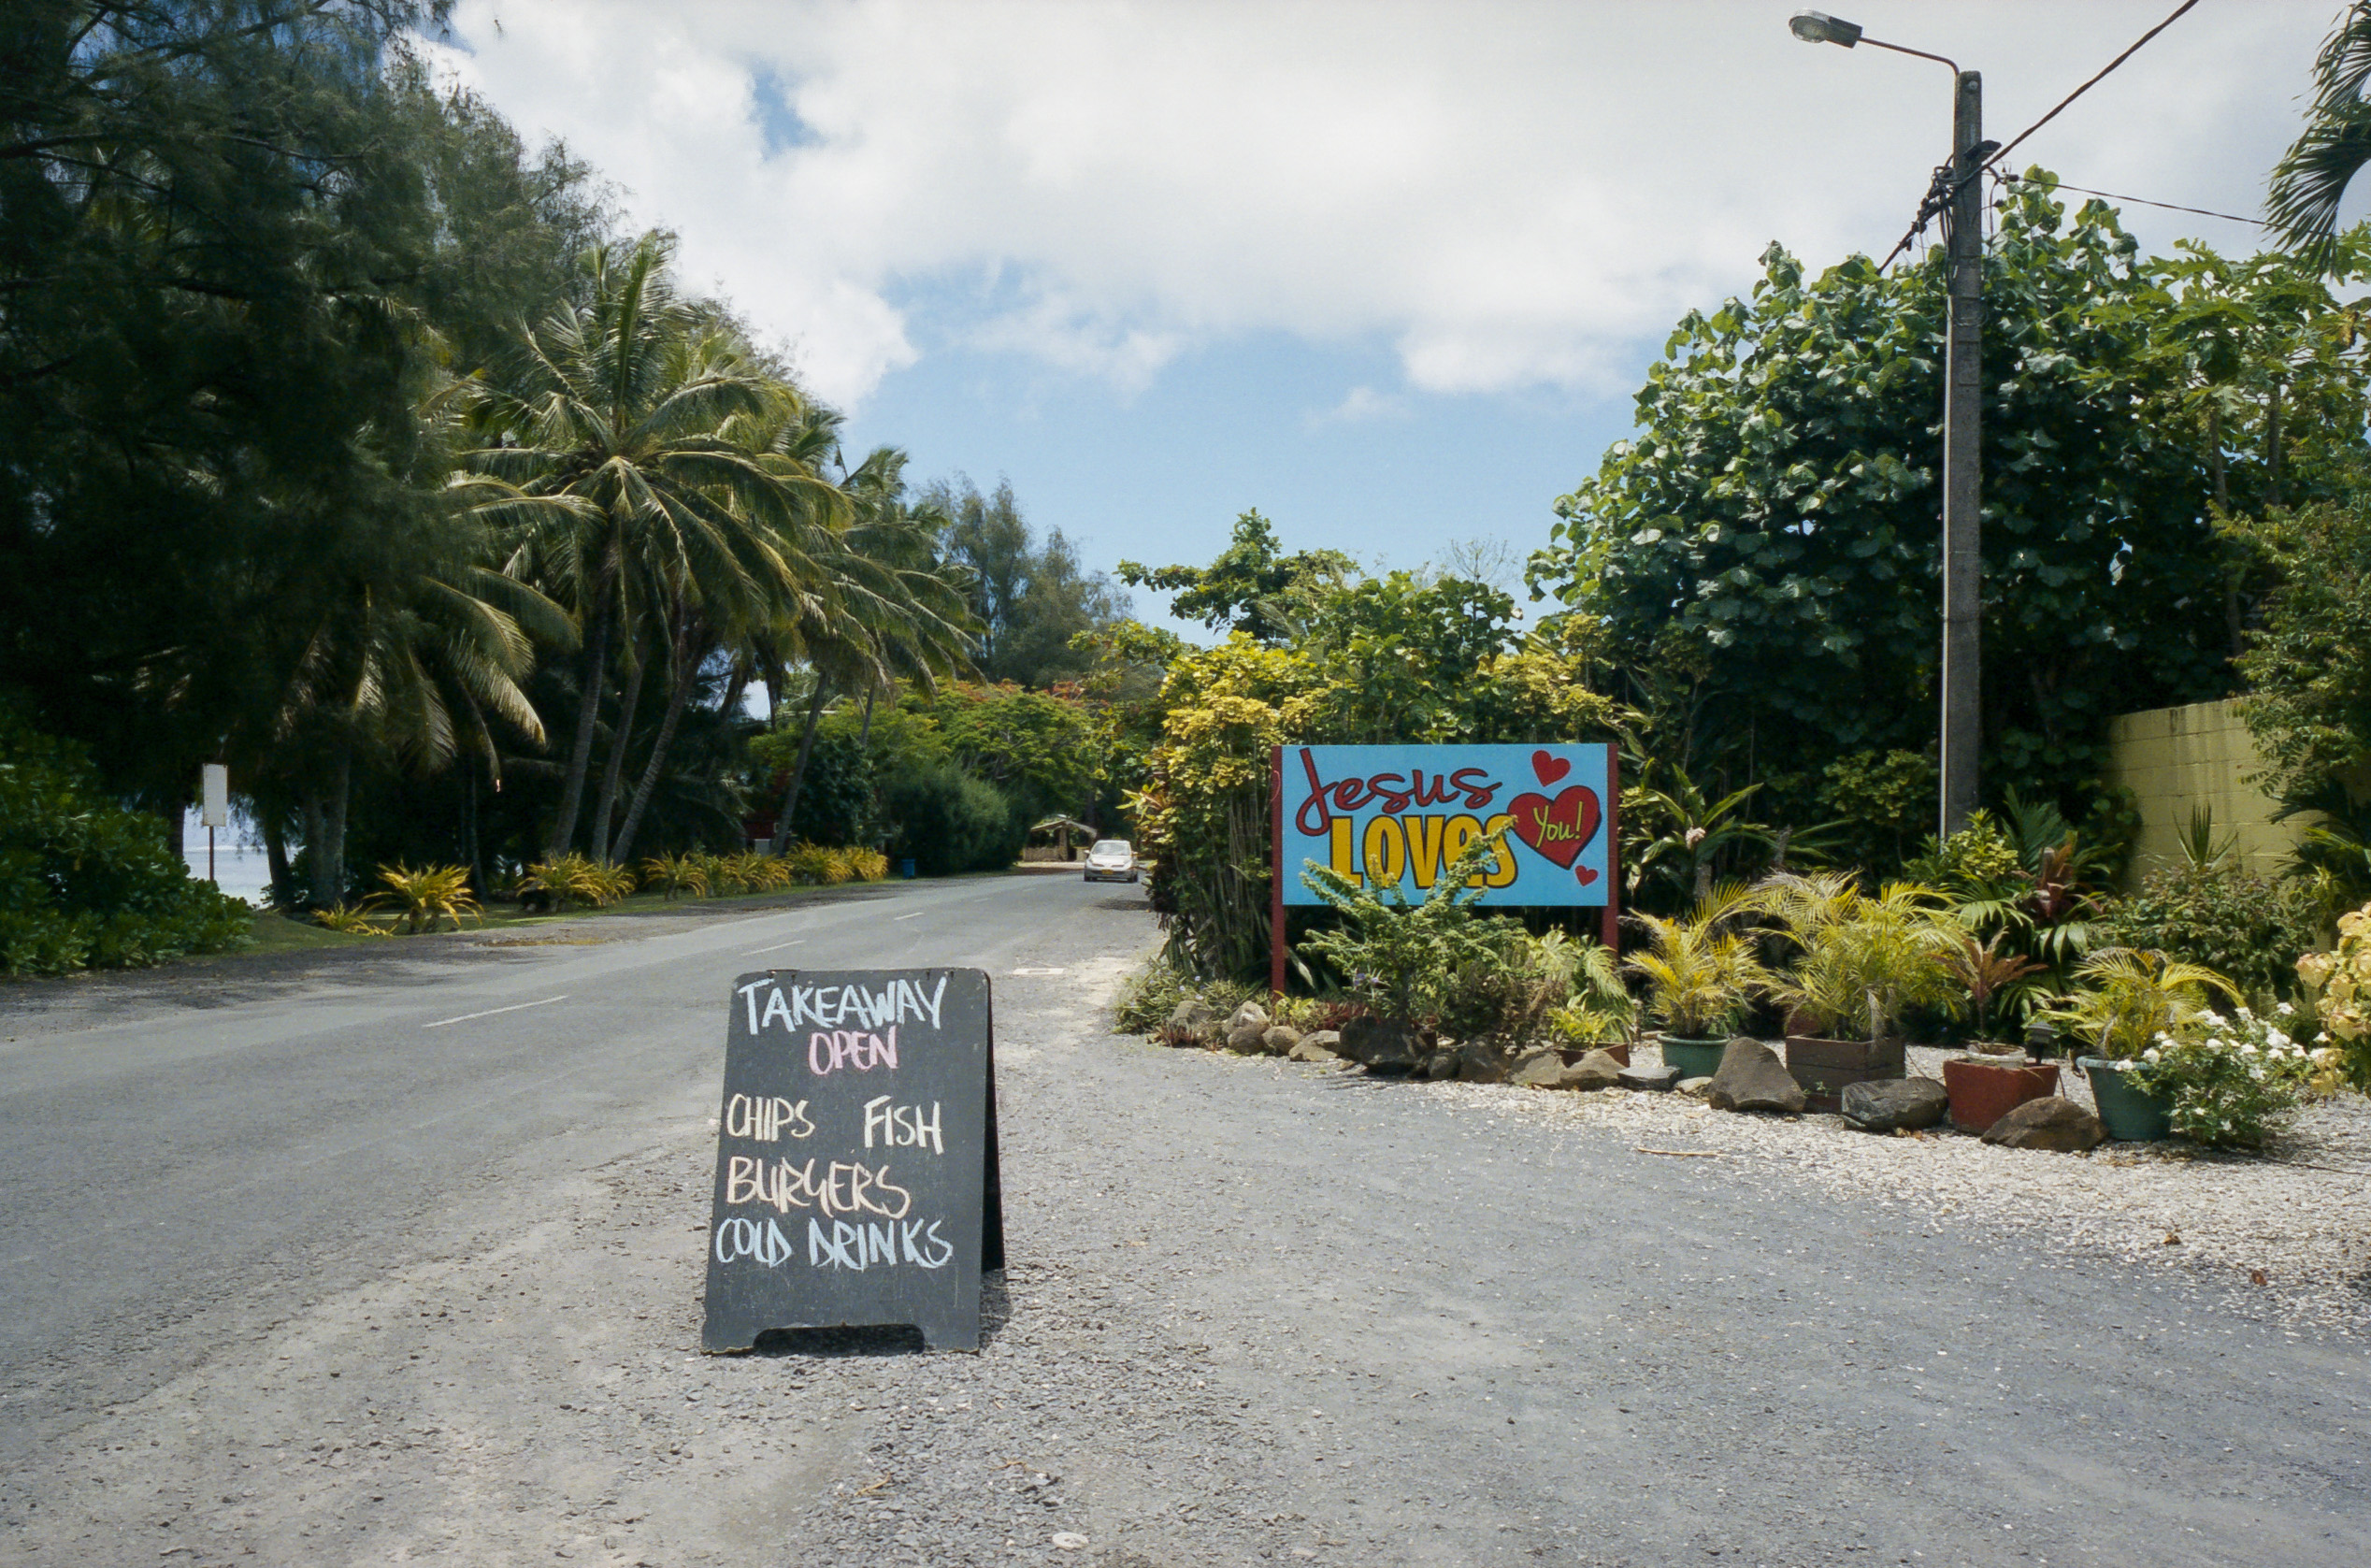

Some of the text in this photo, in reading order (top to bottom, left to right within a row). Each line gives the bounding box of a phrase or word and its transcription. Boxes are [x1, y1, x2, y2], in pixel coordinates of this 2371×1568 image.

[1296, 748, 1502, 836] Jesus
[1533, 801, 1585, 848] You!
[738, 976, 947, 1035] TAKEAWAY
[808, 1025, 898, 1075] OPEN
[726, 1093, 944, 1155] CHIPS FISH
[726, 1156, 912, 1219] BURGERS
[716, 1217, 954, 1273] COLD DRINKS
